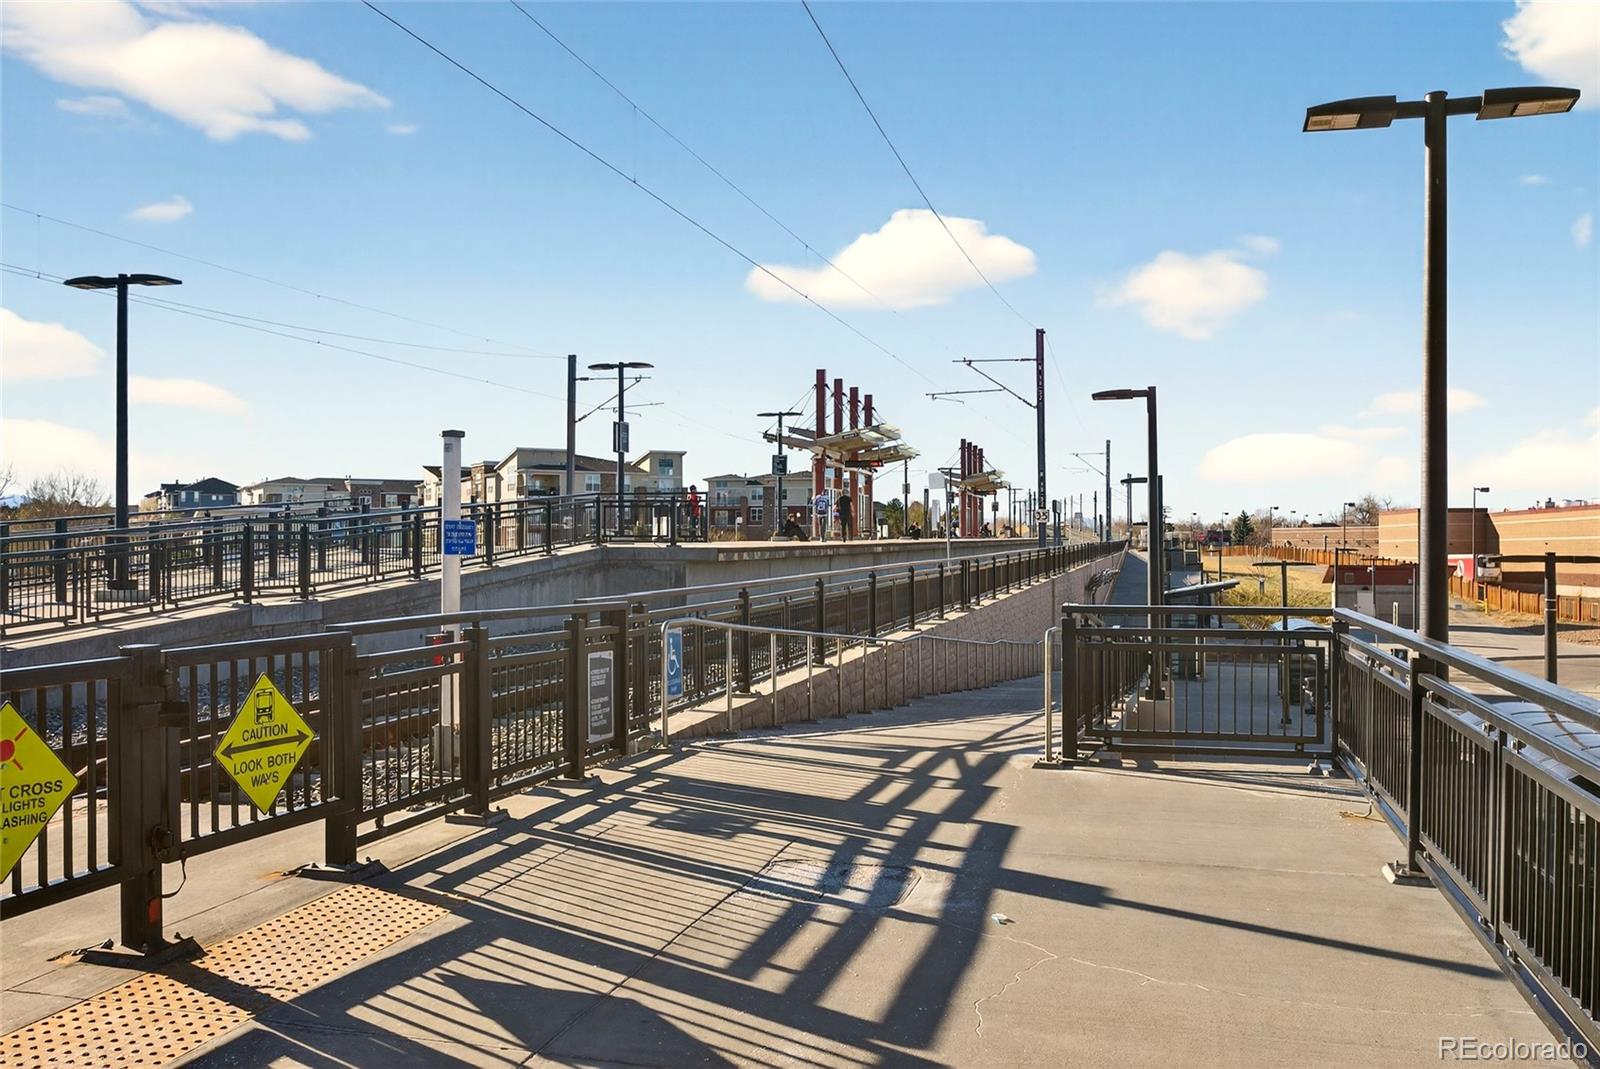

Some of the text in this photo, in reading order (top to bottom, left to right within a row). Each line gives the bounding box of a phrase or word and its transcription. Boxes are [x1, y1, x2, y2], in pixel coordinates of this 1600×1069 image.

[242, 723, 288, 742] CAUTION
[233, 752, 296, 776] LOOK BOTH
[251, 770, 279, 788] WAYS
[9, 779, 63, 799] CROSS
[2, 797, 46, 813] LIGHTS
